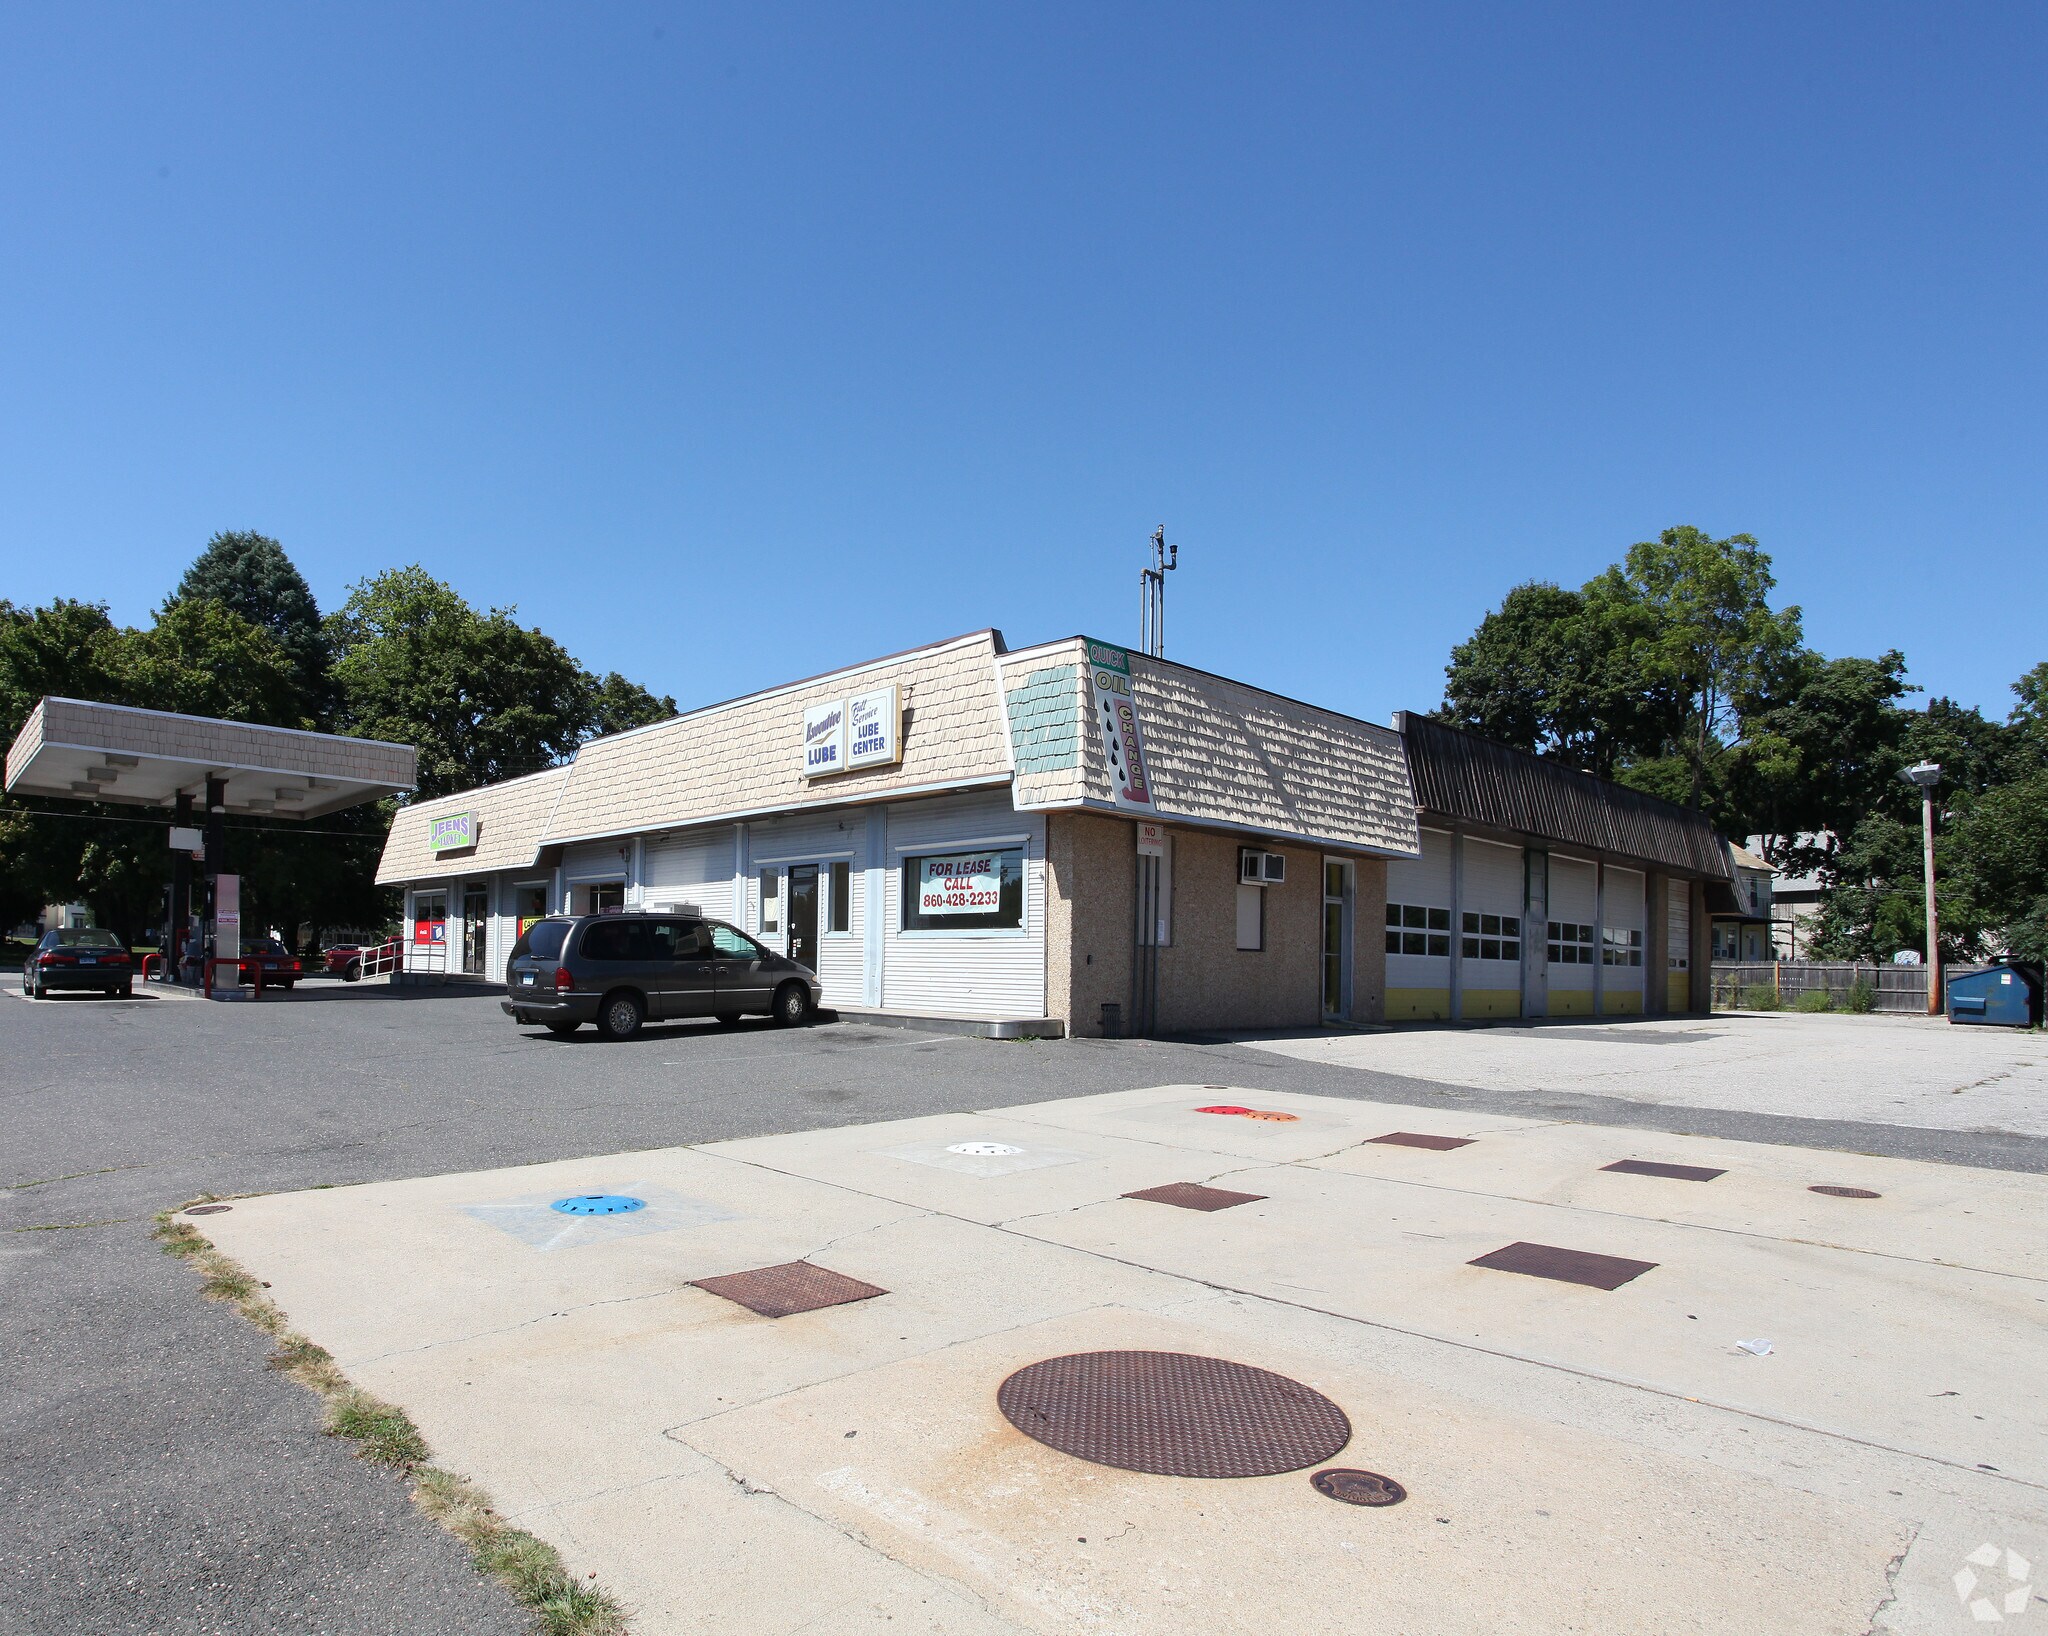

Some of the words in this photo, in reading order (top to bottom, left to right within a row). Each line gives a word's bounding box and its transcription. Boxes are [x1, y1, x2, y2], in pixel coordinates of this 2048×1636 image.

[1091, 645, 1125, 669] QUICK
[1095, 671, 1130, 696] OIL
[851, 699, 868, 716] Full
[852, 706, 878, 727] Service
[805, 710, 841, 743] Executive
[858, 722, 879, 739] LUBE
[808, 744, 837, 766] LUBE
[853, 736, 885, 756] CENTER
[1118, 705, 1144, 789] CHANGE
[431, 816, 469, 842] JEENS
[1144, 827, 1156, 837] NO
[438, 833, 462, 847] MARKET
[1139, 836, 1163, 847] LOITERING
[929, 863, 953, 876] FOR
[956, 859, 991, 875] LEASE
[944, 877, 973, 891] CALL
[923, 890, 998, 908] 860-428-2233
